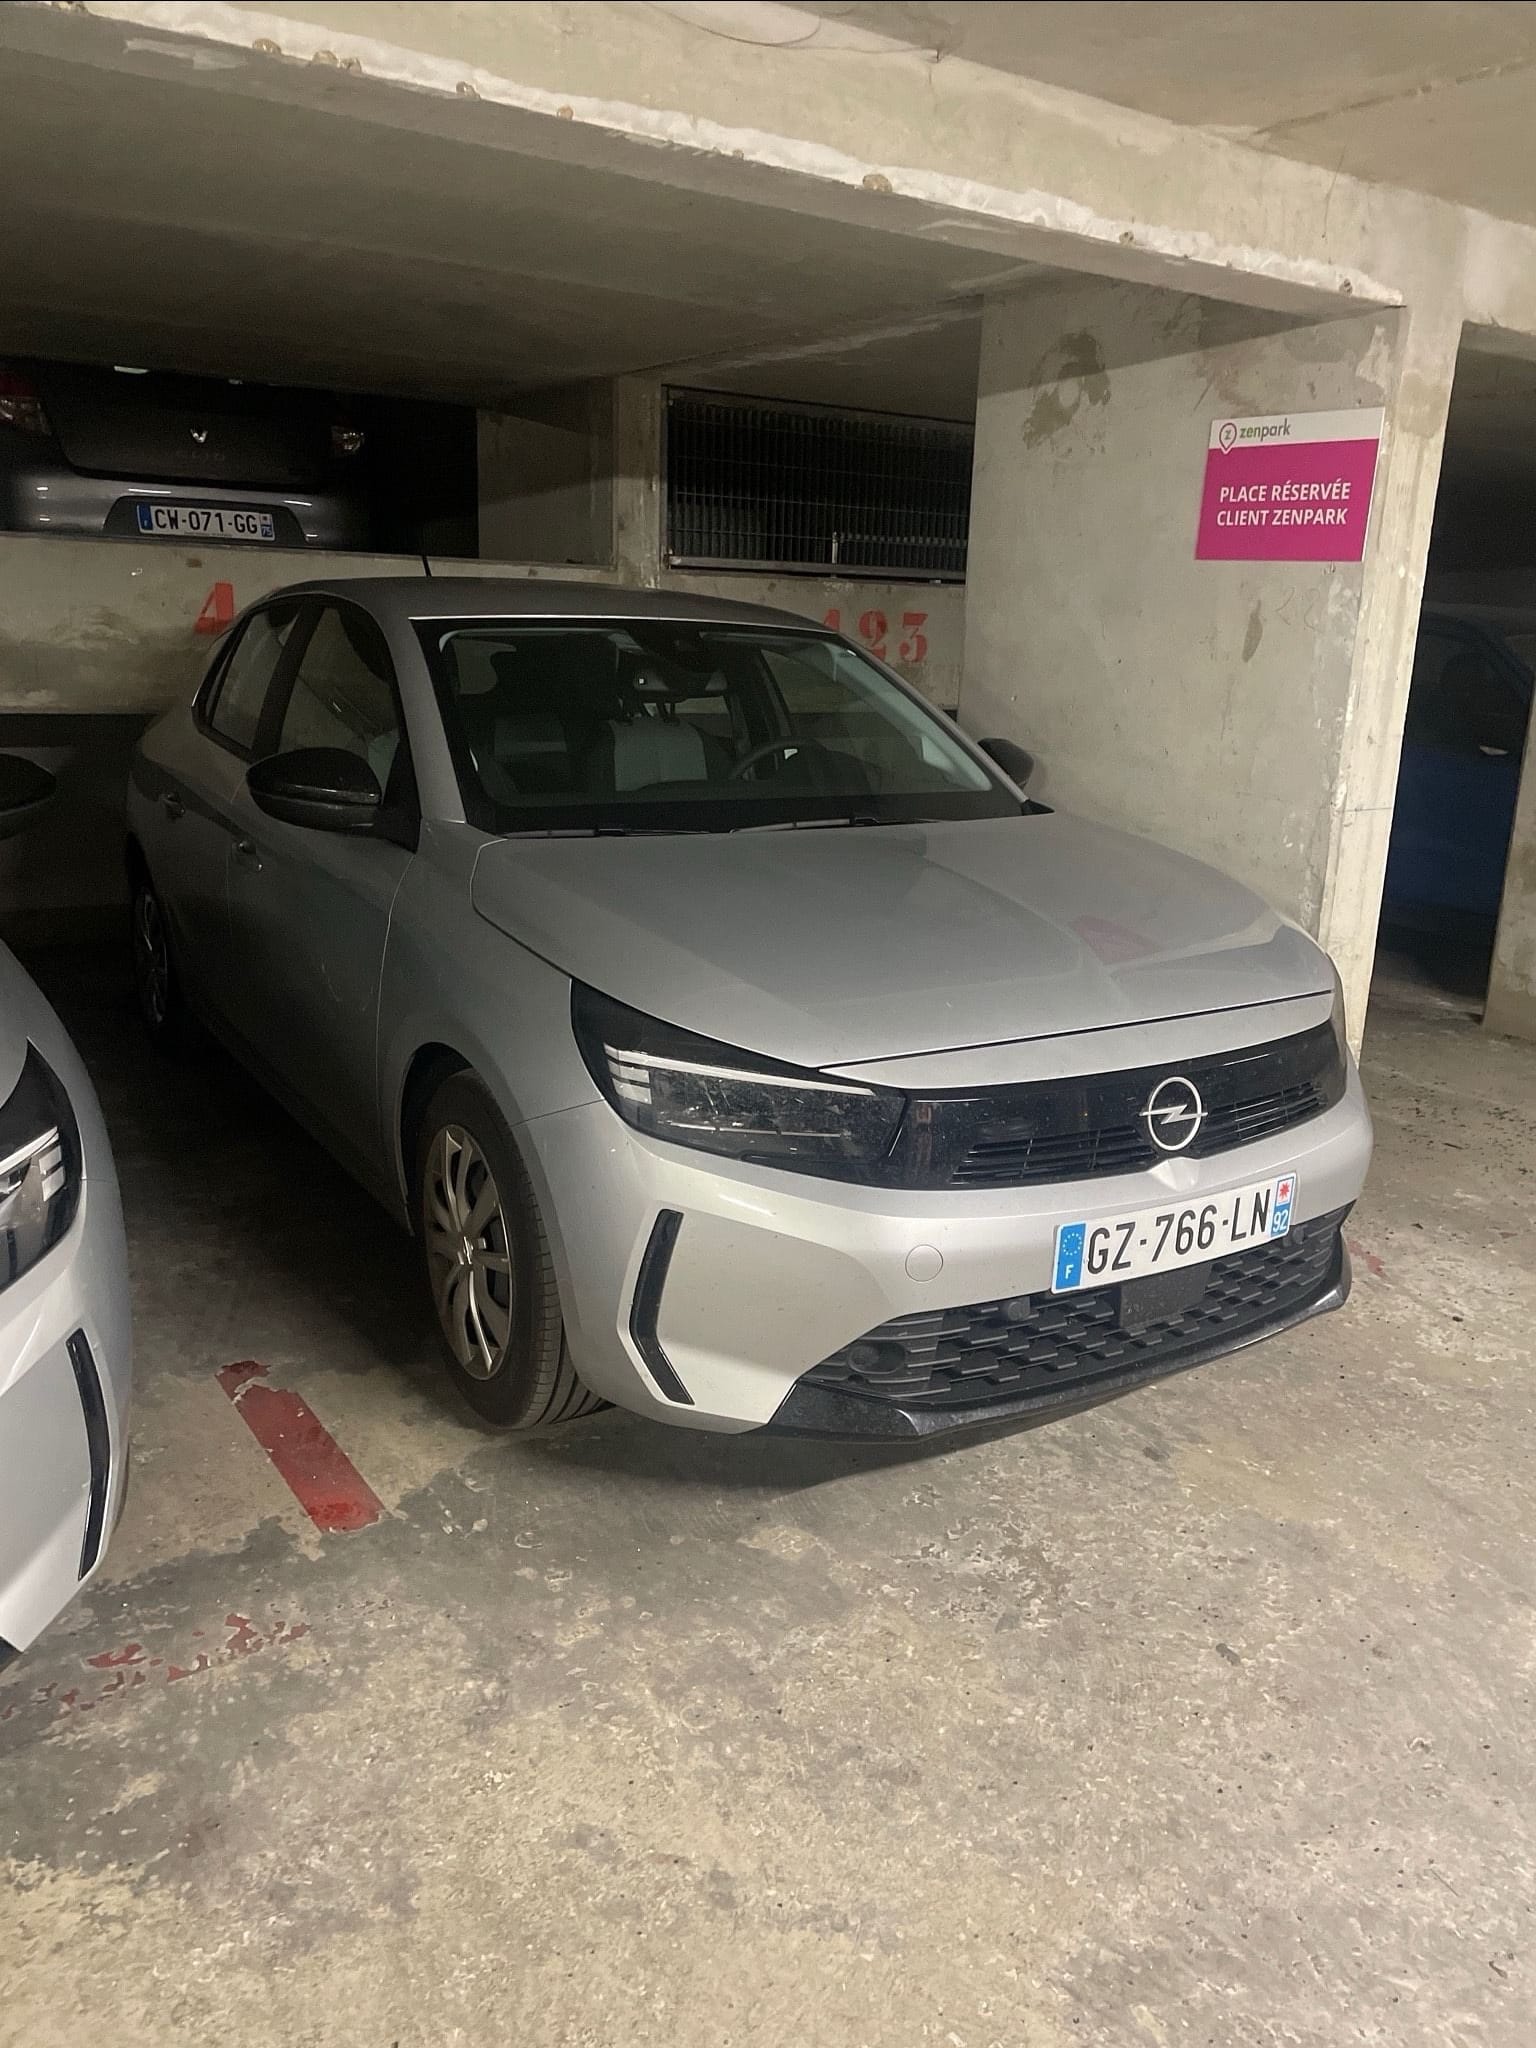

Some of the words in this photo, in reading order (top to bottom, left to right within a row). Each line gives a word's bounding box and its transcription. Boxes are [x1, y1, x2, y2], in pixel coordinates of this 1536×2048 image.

[1239, 418, 1291, 442] zenpark
[1219, 484, 1268, 503] PLACE
[1271, 477, 1352, 502] RÉSERVÉE
[154, 508, 259, 534] CW-071-GG
[1216, 509, 1270, 527] CLIENT
[1271, 507, 1349, 526] ZENPARK
[1086, 1188, 1271, 1275] GZ-766-LN
[1272, 1208, 1289, 1233] 92
[1064, 1264, 1075, 1281] F
